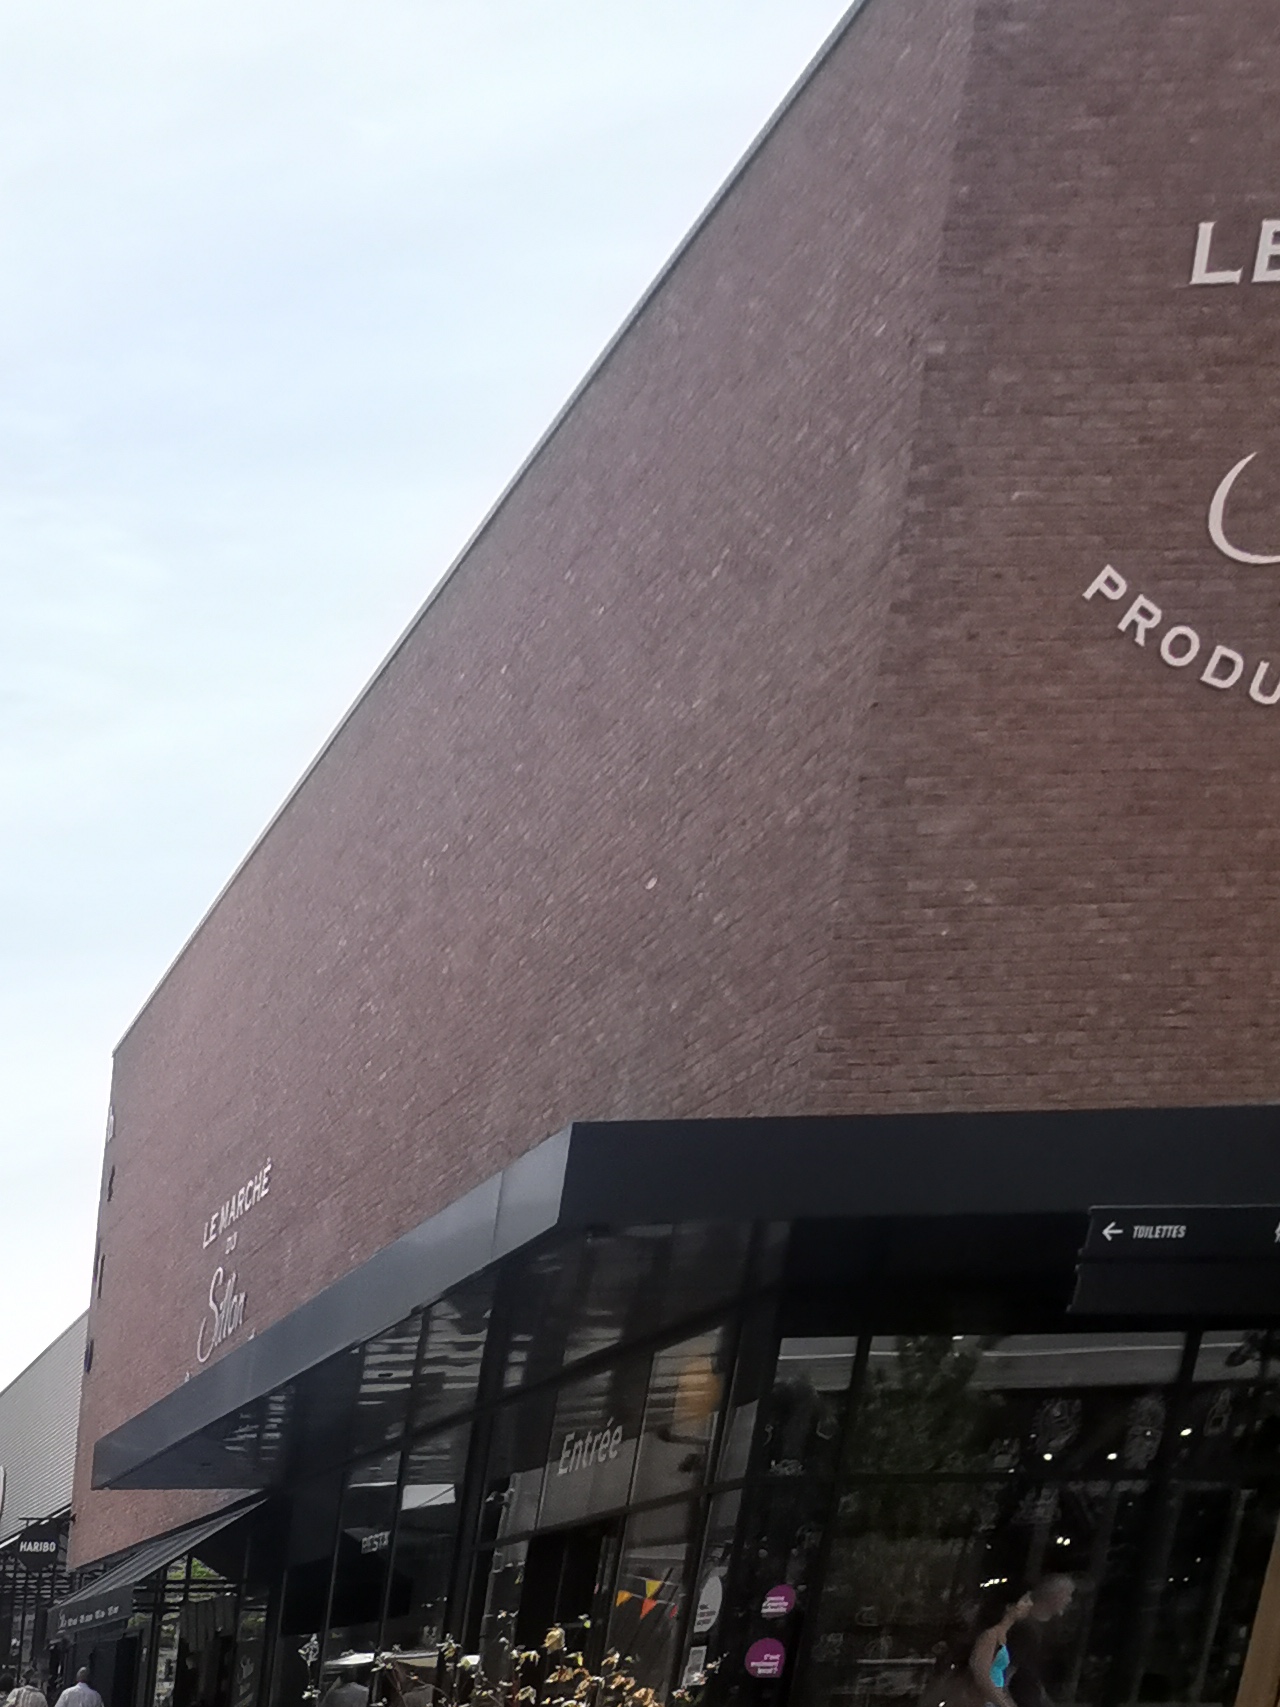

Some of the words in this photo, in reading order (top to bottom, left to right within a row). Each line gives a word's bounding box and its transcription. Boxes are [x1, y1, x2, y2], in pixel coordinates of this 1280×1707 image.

[203, 1212, 220, 1250] LE
[219, 1156, 272, 1235] MARCHÉ
[1132, 1224, 1188, 1240] TOILETTES
[557, 1416, 623, 1475] Entrée
[19, 1540, 57, 1553] HARIBO
